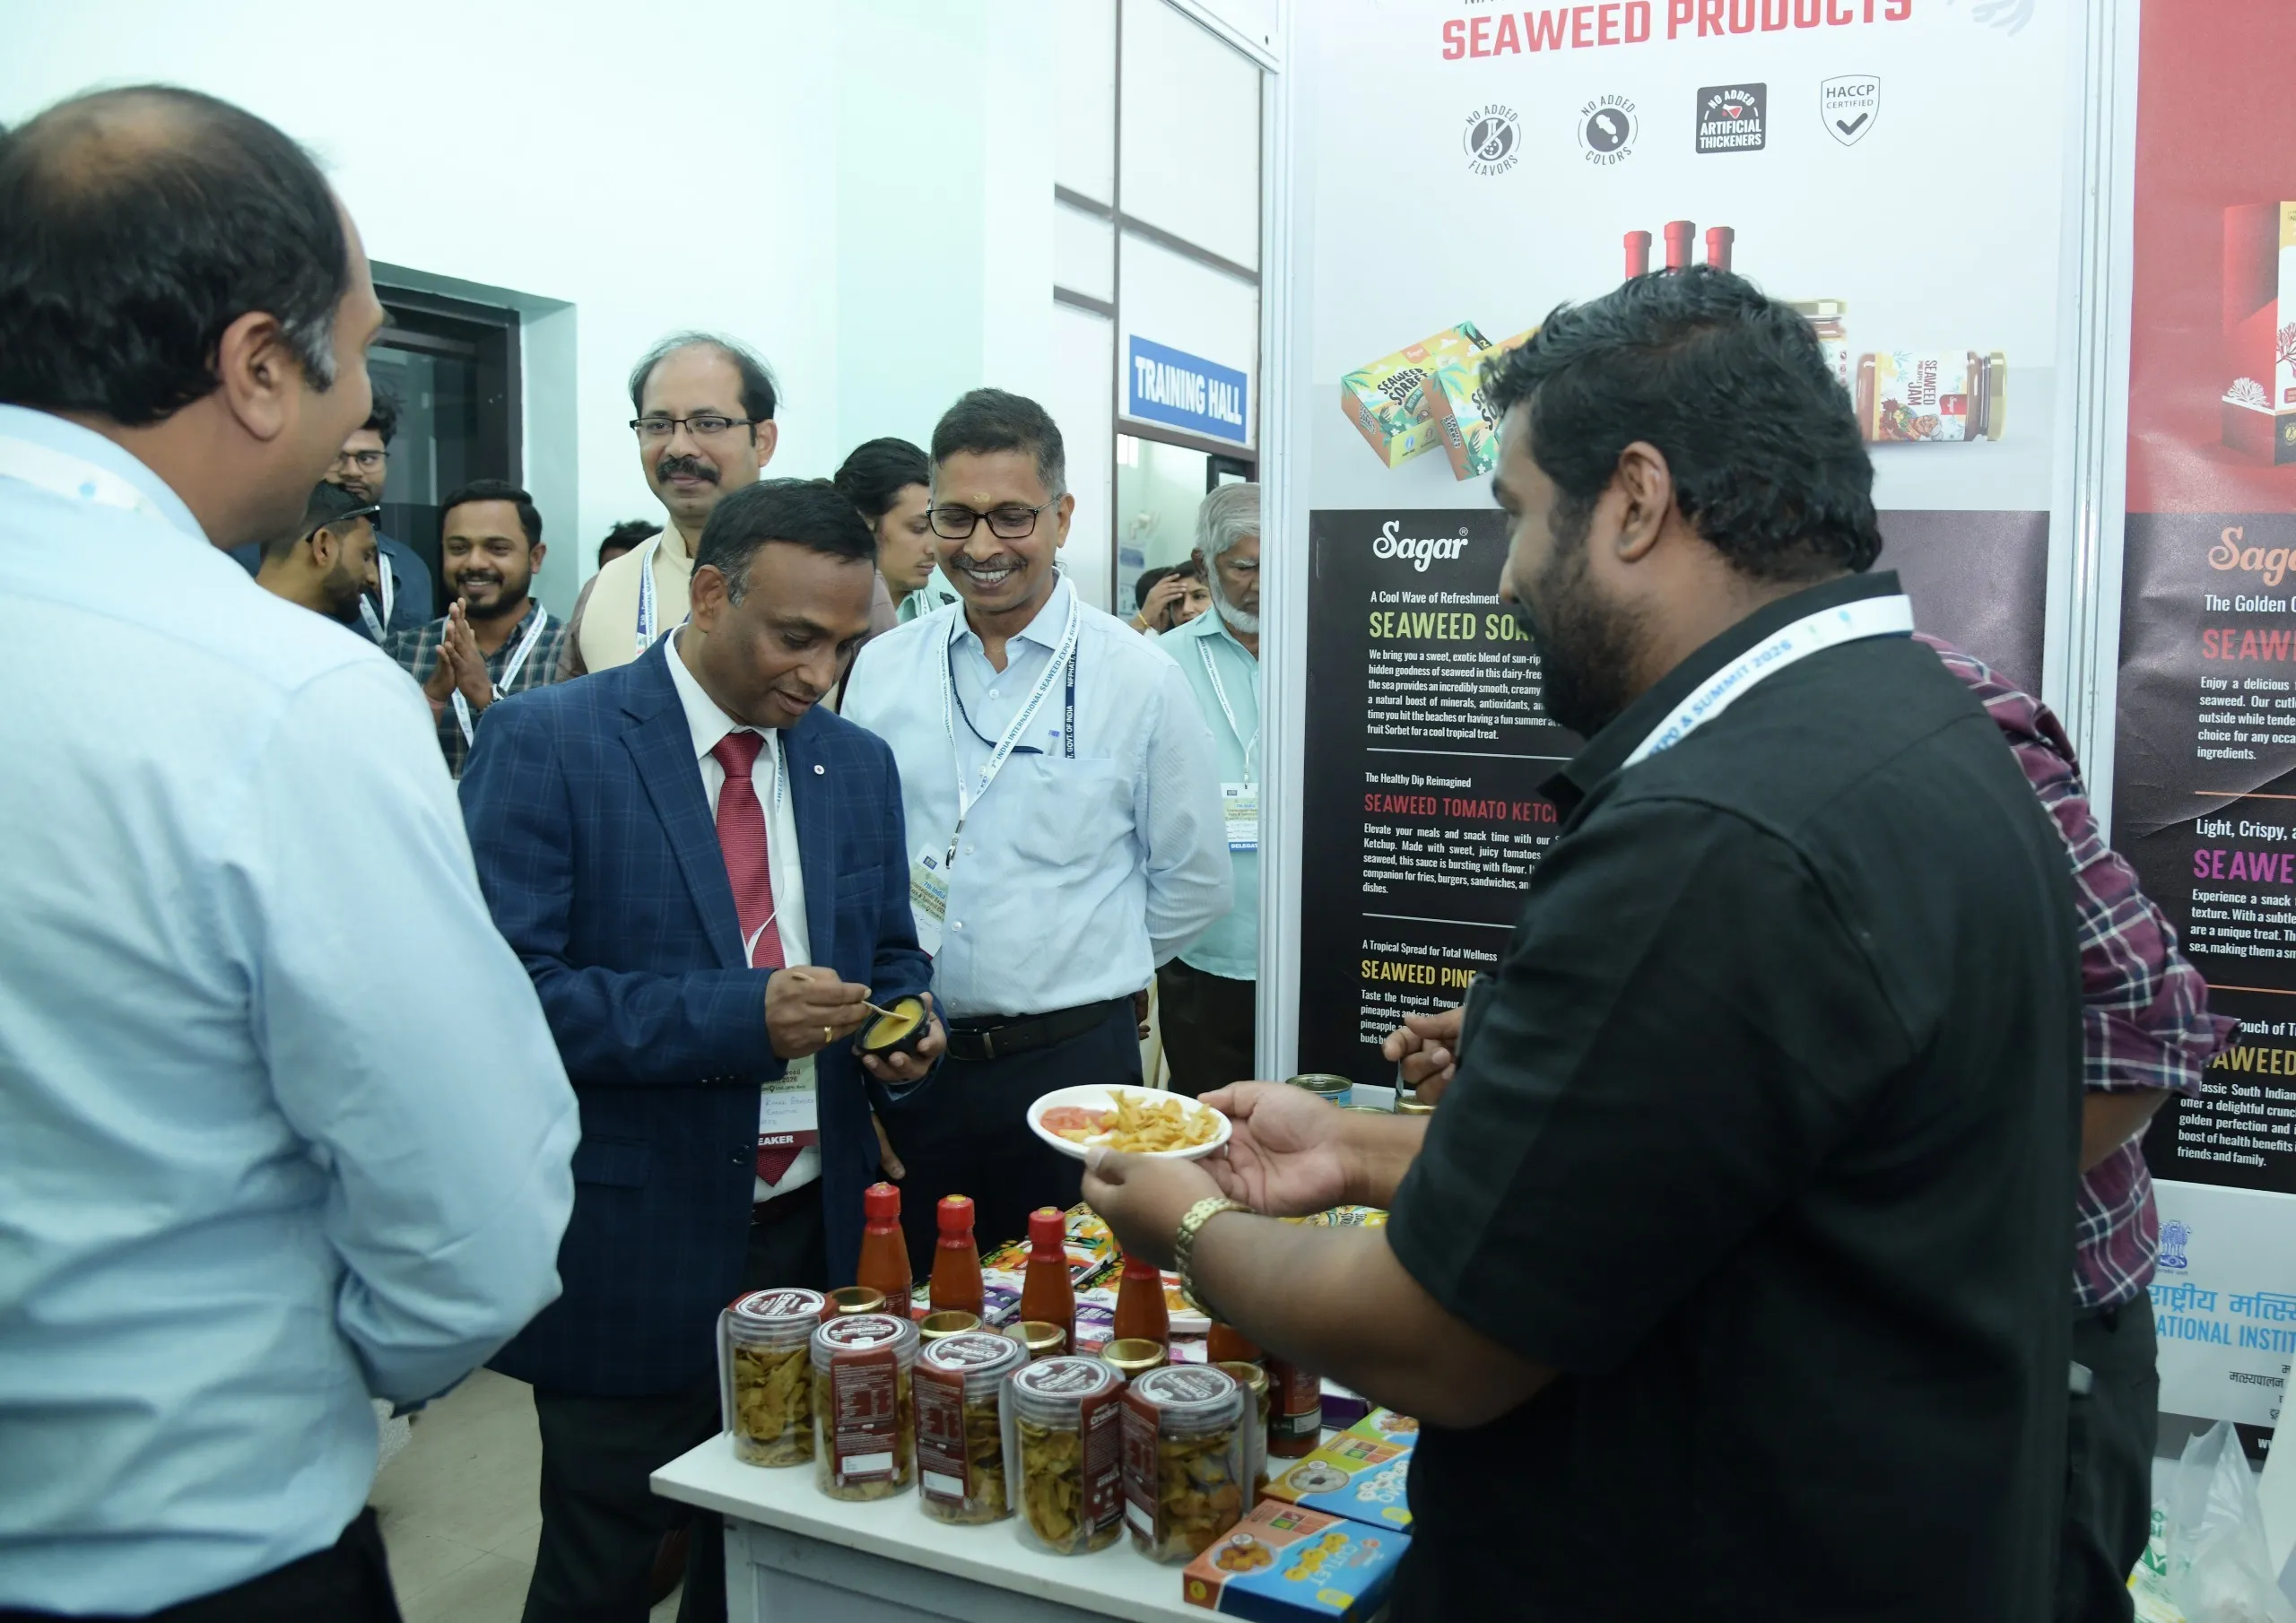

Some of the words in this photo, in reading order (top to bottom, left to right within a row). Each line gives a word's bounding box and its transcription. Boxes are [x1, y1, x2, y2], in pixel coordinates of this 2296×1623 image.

[1442, 1, 1650, 61] SEAWEED
[1708, 94, 1722, 109] NO
[1724, 89, 1755, 106] ADDED
[1826, 84, 1875, 99] HACCP
[1581, 100, 1596, 117] NO
[1600, 94, 1636, 114] ADDED
[1826, 99, 1874, 109] CERTIFIED
[1465, 110, 1481, 126] NO
[1484, 104, 1518, 123] ADDED
[1700, 119, 1762, 135] ARTIFICIAL
[1700, 134, 1762, 149] THICKENERS
[1468, 154, 1518, 177] FLAVORS
[1586, 146, 1632, 166] COLORS
[1135, 355, 1205, 415] TRAINING
[1208, 378, 1242, 425] HALL
[1378, 368, 1424, 395] SEAWEED
[1923, 360, 1937, 405] SEAWEED
[1908, 382, 1922, 405] JAM
[2208, 525, 2296, 586] Sag
[1370, 590, 1377, 603] A
[1378, 590, 1399, 603] Cool
[1401, 591, 1426, 603] Wave
[1428, 592, 1439, 603] of
[1440, 591, 1500, 604] Refreshment
[2204, 594, 2230, 612] The
[2234, 594, 2285, 612] Golden
[1369, 611, 1475, 639] SEAWEED
[2202, 629, 2296, 662] SEAW
[1369, 648, 1381, 659] We
[1382, 649, 1403, 662] bring
[1404, 652, 1417, 662] you
[1425, 651, 1451, 662] sweet,
[1452, 652, 1476, 662] exotic
[1478, 651, 1500, 663] blend
[1501, 653, 1510, 663] of
[1511, 654, 1540, 665] sun-rip
[1682, 716, 1692, 728] &
[1692, 664, 1750, 717] SUMMIT
[1752, 639, 1793, 669] 2026
[2200, 674, 2228, 690] Enjoy
[2231, 680, 2239, 689] a
[2243, 677, 2289, 690] delicious
[996, 742, 1012, 760] INDIA
[1007, 691, 1043, 742] INTERNATIONAL
[1039, 660, 1063, 692] SEAWEED
[1059, 642, 1071, 661] EXPO
[2199, 695, 2246, 707] seaweed.
[2250, 695, 2270, 707] Our
[2274, 696, 2296, 708] cutl
[1065, 723, 1074, 733] OF
[1367, 724, 1384, 734] fruit
[1384, 724, 1410, 735] Sorbet
[1410, 725, 1422, 735] for
[1428, 726, 1445, 736] cool
[1446, 727, 1476, 739] tropical
[1476, 728, 1499, 739] treat.
[2197, 728, 2231, 741] choice
[2233, 730, 2248, 742] for
[2250, 733, 2269, 744] any
[2271, 733, 2296, 743] occa
[1066, 733, 1074, 751] GOVT.
[2196, 745, 2257, 759] ingredients.
[1365, 771, 1378, 782] The
[1380, 772, 1410, 785] Healthy
[1411, 774, 1424, 786] Dip
[1426, 775, 1471, 788] Reimagined
[1364, 793, 1436, 815] SEAWEED
[1442, 797, 1506, 820] TOMATO
[1512, 802, 1556, 822] KETC
[1363, 822, 1391, 834] Elevate
[1396, 827, 1413, 837] your
[1417, 827, 1440, 838] meals
[1444, 829, 1458, 838] and
[1463, 830, 1486, 840] snack
[1491, 831, 1509, 842] time
[1513, 833, 1532, 844] with
[1535, 837, 1550, 845] our
[2196, 818, 2235, 838] Light,
[2239, 820, 2287, 841] Crispy,
[1363, 838, 1397, 851] Ketchup.
[1401, 840, 1422, 852] Made
[1427, 842, 1444, 853] with
[1448, 845, 1474, 856] sweet,
[1478, 846, 1499, 858] juicy
[1502, 847, 1541, 859] tomatoes
[1363, 854, 1397, 865] seaweed,
[1399, 855, 1413, 865] this
[1415, 858, 1438, 867] sauce
[1439, 858, 1447, 868] is
[1448, 858, 1481, 872] bursting
[1482, 861, 1500, 872] with
[1501, 862, 1526, 874] flavor.
[2193, 848, 2295, 883] SEAWE
[1362, 881, 1388, 893] dishes.
[2192, 888, 2247, 903] Experience
[2250, 895, 2257, 904] a
[2260, 894, 2291, 906] snack
[2190, 907, 2230, 919] texture.
[2231, 908, 2256, 921] With
[2257, 913, 2264, 922] a
[2265, 911, 2296, 924] subtle
[1361, 939, 1368, 949] A
[1369, 940, 1399, 952] Tropical
[1400, 942, 1427, 955] Spread
[1429, 945, 1440, 956] for
[1441, 946, 1461, 958] Total
[1463, 948, 1497, 961] Wellness
[1361, 959, 1435, 985] SEAWEED
[1361, 989, 1381, 1001] Taste
[1384, 992, 1396, 1002] the
[1400, 994, 1429, 1006] tropical
[1432, 996, 1459, 1009] flavour
[1361, 1004, 1400, 1018] pineapples
[2240, 1020, 2268, 1034] ouch
[2272, 1022, 2285, 1035] of
[2212, 1046, 2296, 1076] AWEED
[2179, 1113, 2212, 1126] golden
[2215, 1118, 2267, 1132] perfection
[2271, 1123, 2290, 1134] and
[2177, 1145, 2212, 1159] friends
[2213, 1150, 2231, 1162] and
[2232, 1151, 2266, 1167] family.
[2156, 1314, 2232, 1345] ATIONAL
[2239, 1324, 2296, 1354] INSTIT
